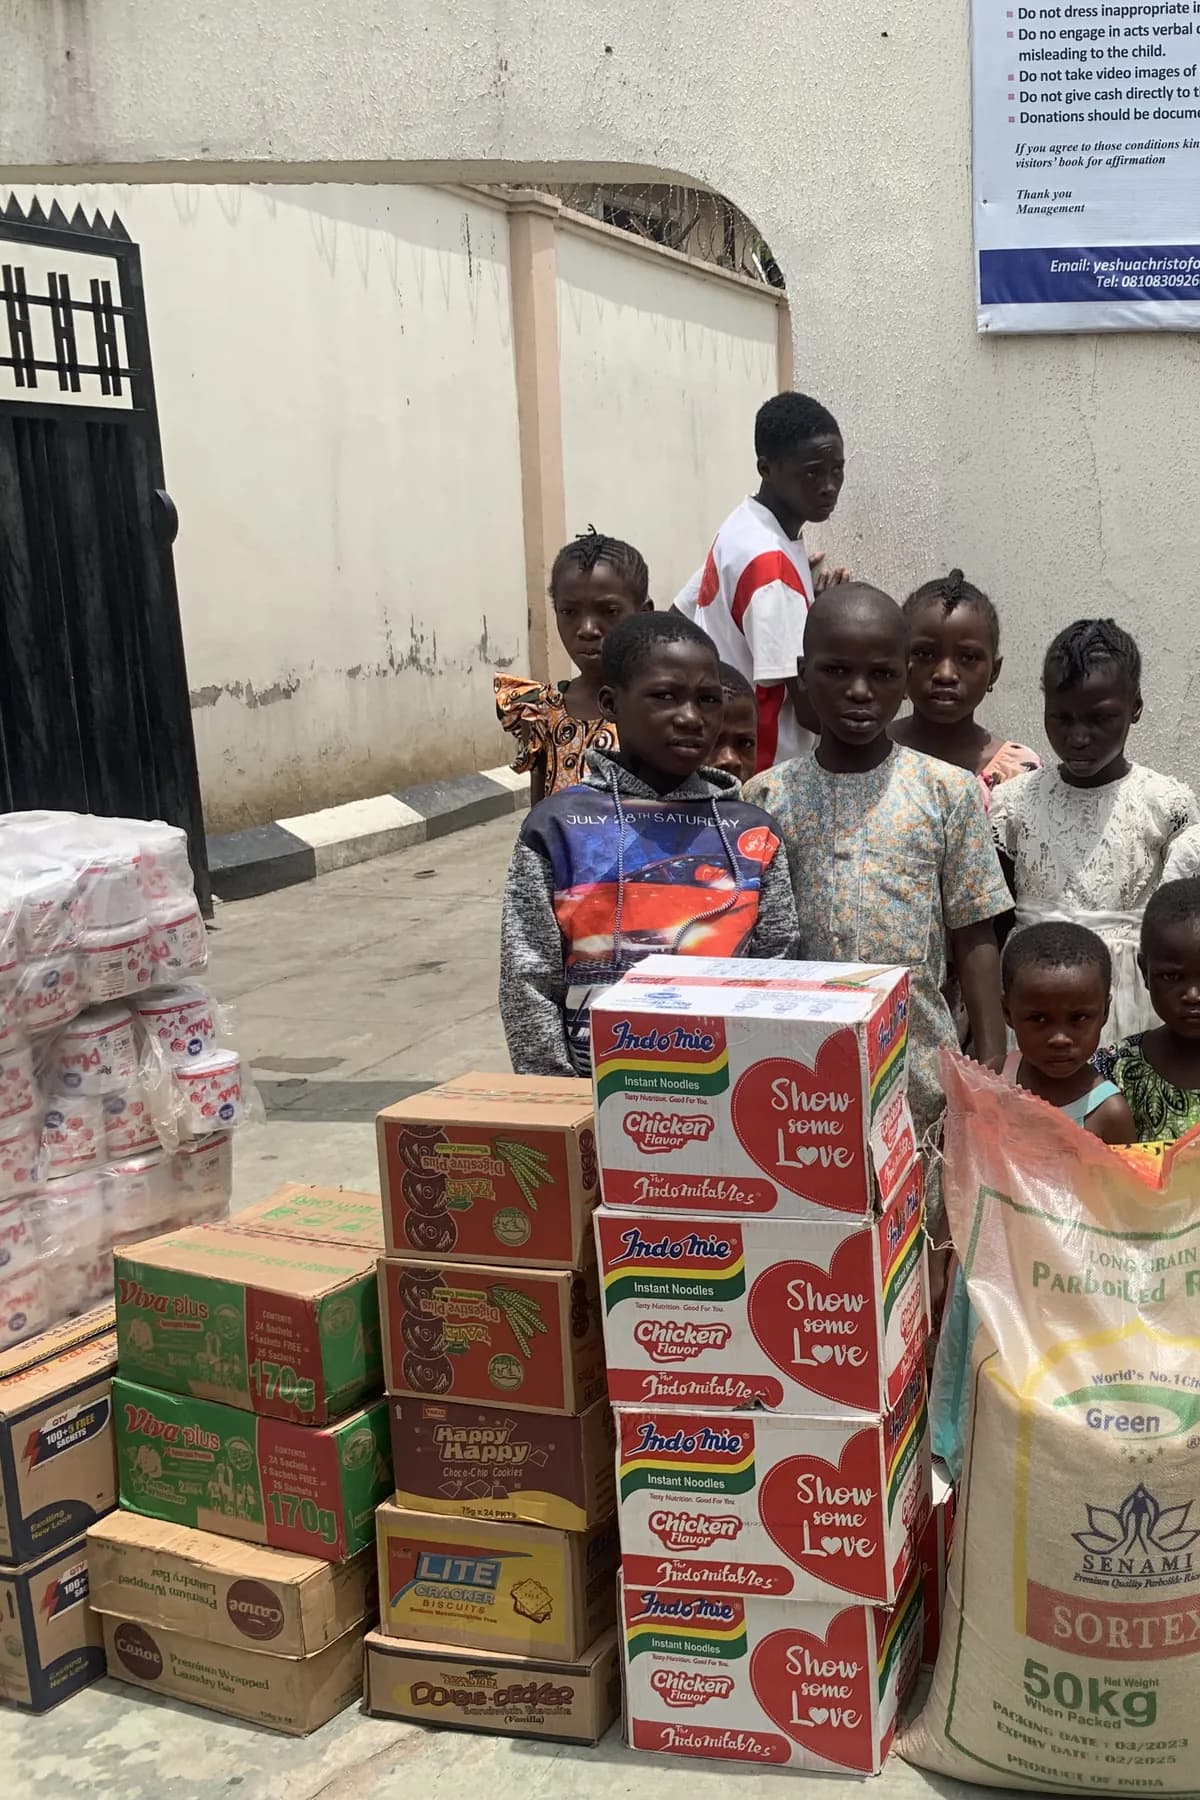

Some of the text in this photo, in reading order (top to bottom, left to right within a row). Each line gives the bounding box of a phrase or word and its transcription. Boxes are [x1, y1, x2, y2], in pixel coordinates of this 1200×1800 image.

[1018, 7, 1036, 20] Do
[1039, 6, 1062, 19] not
[1064, 4, 1098, 18] dress
[1100, 1, 1190, 19] inappropriate
[1018, 28, 1036, 41] Do
[1039, 29, 1056, 40] no
[1058, 28, 1106, 42] engage
[1108, 24, 1120, 38] in
[1123, 24, 1150, 37] acts
[1152, 21, 1192, 36] verbal
[1018, 43, 1166, 63] misleading to the child.
[1019, 70, 1037, 82] Do
[1040, 69, 1062, 82] not
[1064, 67, 1093, 81] take
[1095, 66, 1132, 80] video
[1134, 65, 1180, 81] images
[1182, 63, 1197, 77] of
[1019, 90, 1038, 103] Do
[1040, 90, 1062, 103] not
[1064, 88, 1091, 105] give
[1094, 87, 1122, 101] cash
[1125, 85, 1174, 102] directly
[1176, 86, 1190, 98] to
[1020, 112, 1084, 123] Donations
[1087, 108, 1130, 122] should
[1133, 107, 1150, 120] be
[1015, 143, 1028, 154] If
[1027, 145, 1046, 154] you
[1049, 144, 1078, 154] agree
[1081, 143, 1091, 151] to
[1094, 140, 1122, 151] those
[1125, 139, 1180, 150] conditions
[1058, 155, 1084, 167] book
[1085, 155, 1103, 170] for
[1105, 153, 1166, 168] affirmation
[1016, 188, 1072, 202] Thank you
[1016, 203, 1085, 216] Management
[1050, 258, 1090, 272] Email:
[1096, 274, 1119, 287] Tel:
[566, 815, 608, 825] JULY
[654, 812, 740, 828] SATURDAY
[601, 1020, 714, 1056] Indomie
[624, 1076, 700, 1090] Instant Noodles
[771, 1078, 855, 1112] Show
[626, 1113, 711, 1136] Chicken
[788, 1119, 844, 1135] some
[645, 1134, 683, 1145] Flavor
[422, 1156, 504, 1175] Digestive Plus
[633, 1176, 754, 1206] Indomitables
[609, 1227, 731, 1265] Indomie
[1089, 1250, 1137, 1274] LONG
[634, 1282, 714, 1297] Instant Noodles
[786, 1279, 869, 1313] Show
[119, 1280, 208, 1320] Viva plus
[637, 1323, 727, 1346] Chicken
[803, 1317, 858, 1334] some
[657, 1343, 698, 1355] Flavor
[251, 1359, 315, 1412] 170g
[1091, 1369, 1144, 1386] World's
[52, 1414, 68, 1426] QTY
[125, 1404, 220, 1451] Viva plus
[1086, 1408, 1160, 1433] Green
[436, 1427, 508, 1445] Happy
[625, 1423, 743, 1456] Indomie
[443, 1443, 530, 1463] Happy
[493, 1467, 523, 1477] Cookies
[268, 1491, 338, 1545] 170g
[420, 1557, 497, 1586] LITE
[1083, 1553, 1193, 1573] SENAMI
[118, 1574, 218, 1610] Premium Wrapped
[173, 1574, 217, 1596] Laundry
[415, 1584, 496, 1605] CRACKER
[229, 1599, 282, 1623] Canoe
[422, 1600, 487, 1615] BISCUITS
[630, 1591, 734, 1622] Indomie
[117, 1639, 161, 1664] Canoe
[1104, 1676, 1160, 1688] Net Weight
[1023, 1658, 1158, 1728] 50kg
[1025, 1694, 1122, 1730] When Packed
[992, 1700, 1189, 1751] PACKING DATE 03/2023
